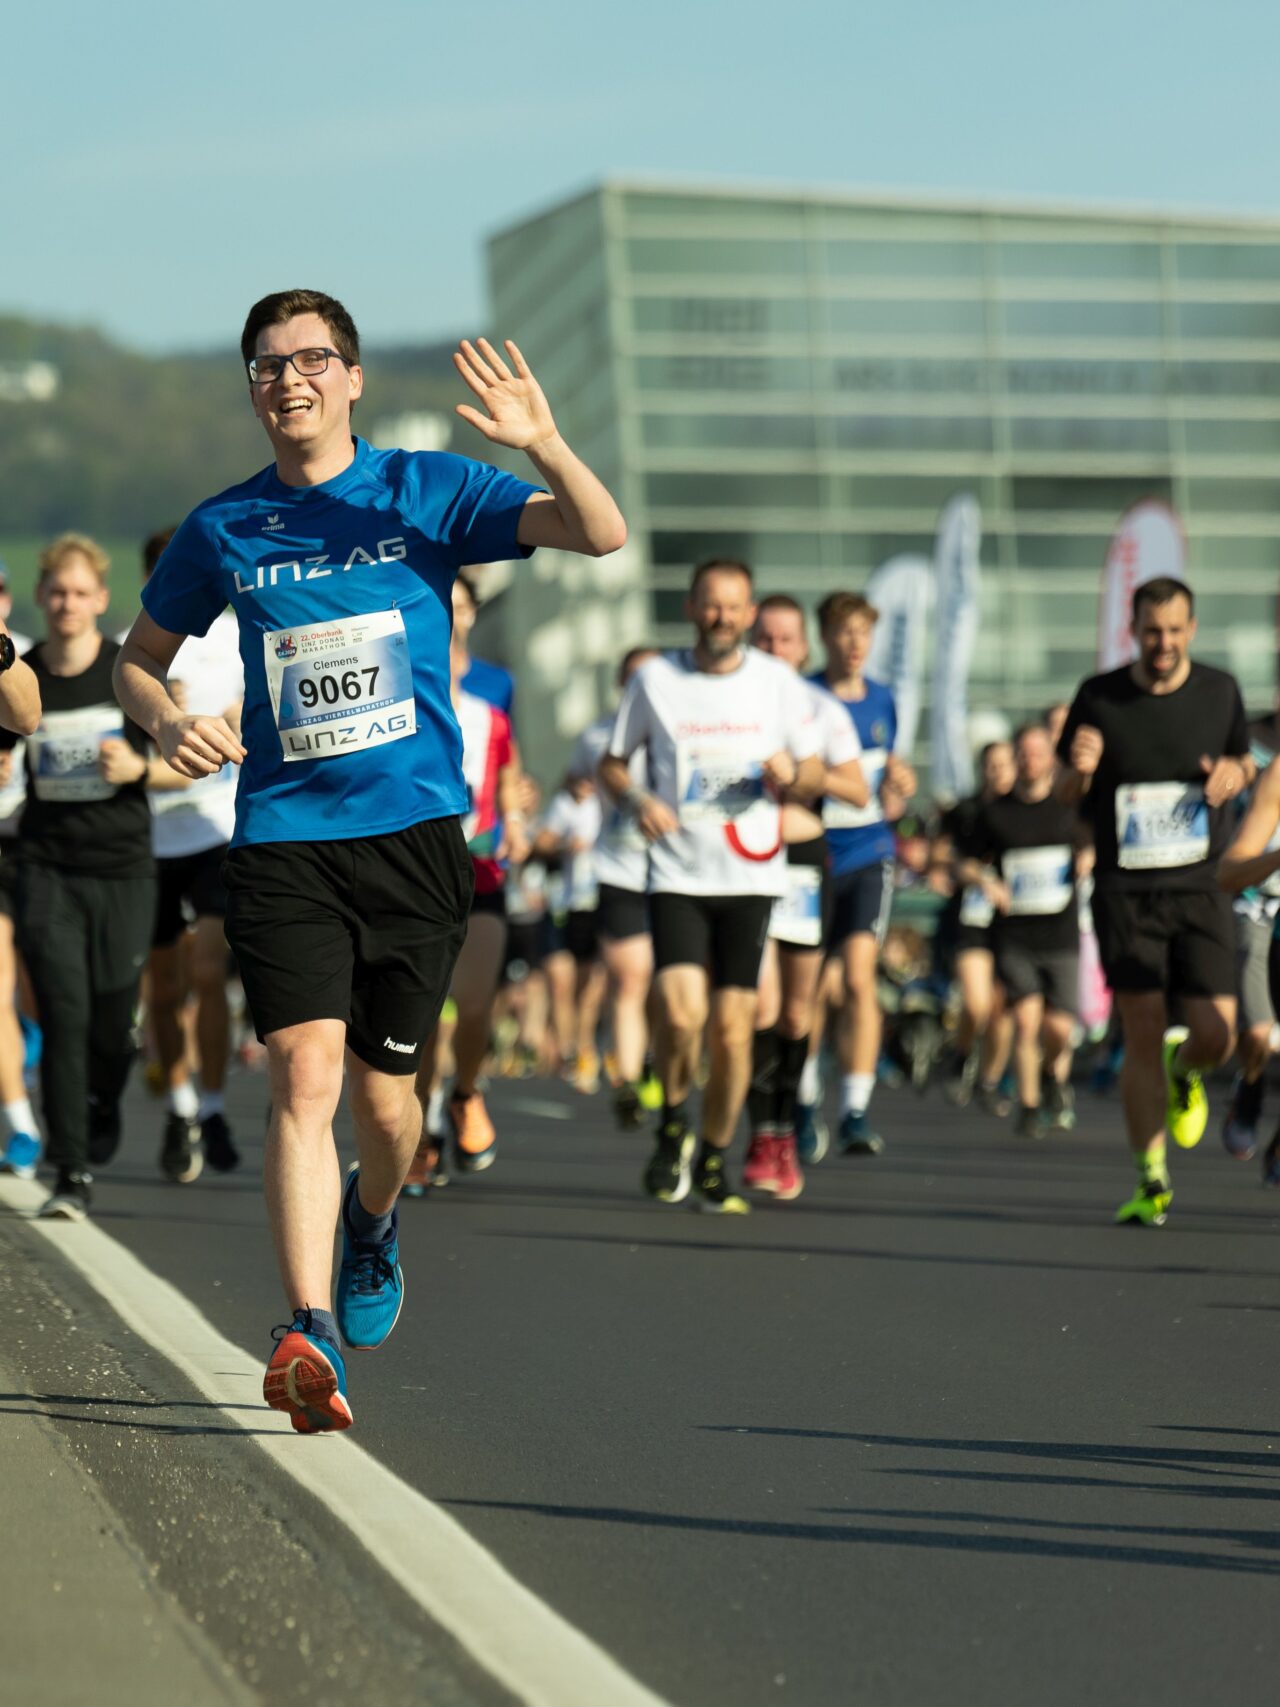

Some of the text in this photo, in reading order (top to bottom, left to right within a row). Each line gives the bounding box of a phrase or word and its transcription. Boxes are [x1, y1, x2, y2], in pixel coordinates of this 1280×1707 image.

[234, 537, 407, 593] LINZ AG
[301, 636, 345, 648] LINZ DONAU
[311, 628, 343, 640] Oberbank
[302, 642, 346, 654] MARATHON
[313, 655, 359, 671] Clemens
[298, 665, 380, 708] 9067
[289, 714, 407, 752] LINZ AG
